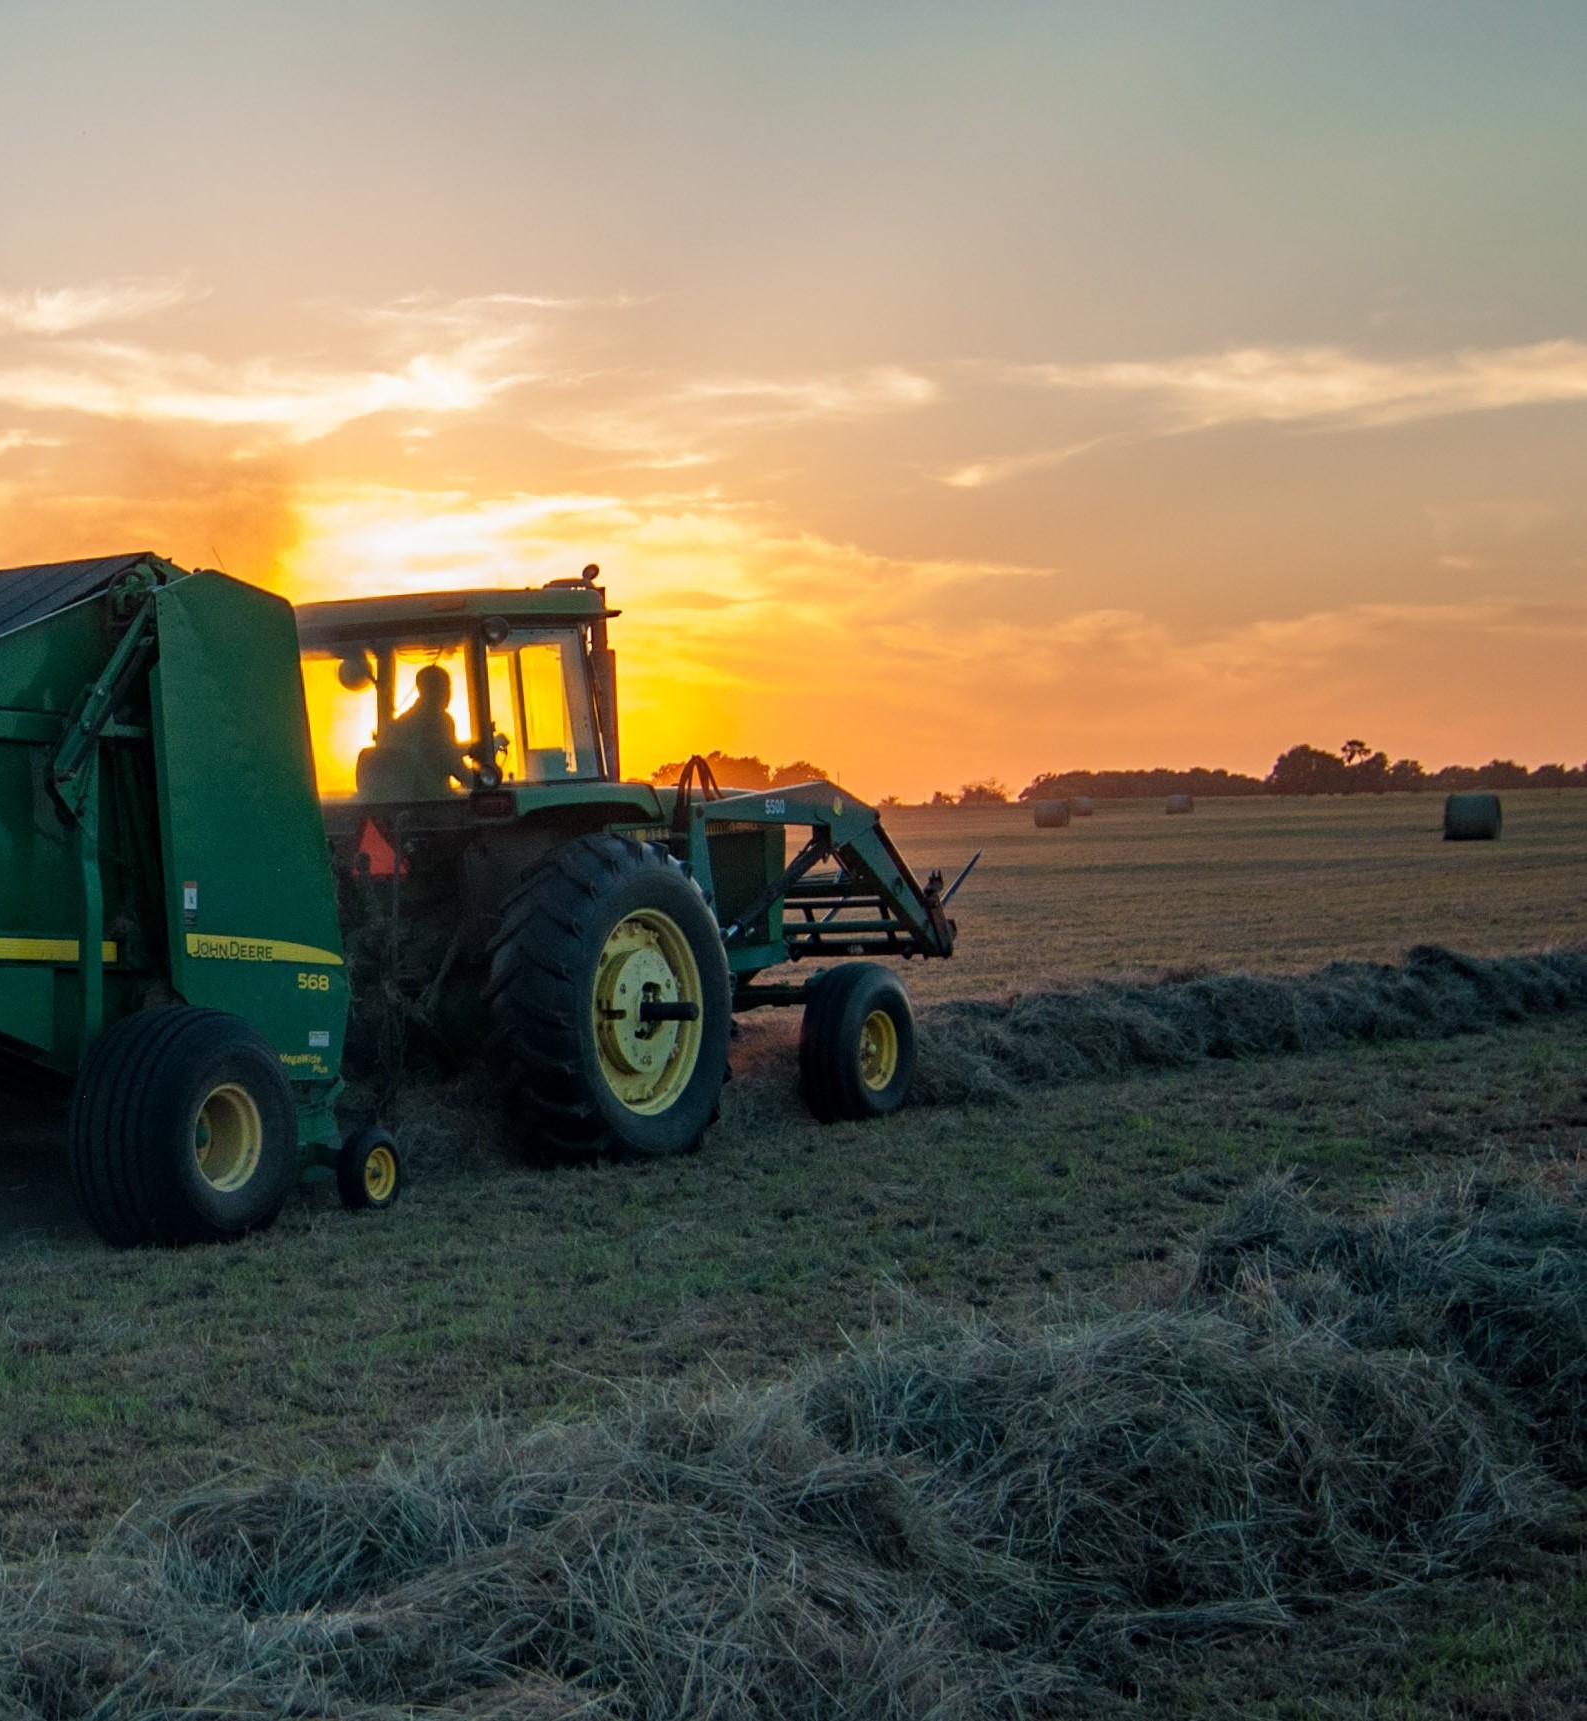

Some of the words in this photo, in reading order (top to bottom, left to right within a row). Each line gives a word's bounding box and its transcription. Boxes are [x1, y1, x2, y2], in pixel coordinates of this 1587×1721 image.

[765, 799, 785, 815] 5500
[192, 939, 228, 958] JOHN
[229, 941, 273, 960] DEERE
[297, 973, 329, 991] 568
